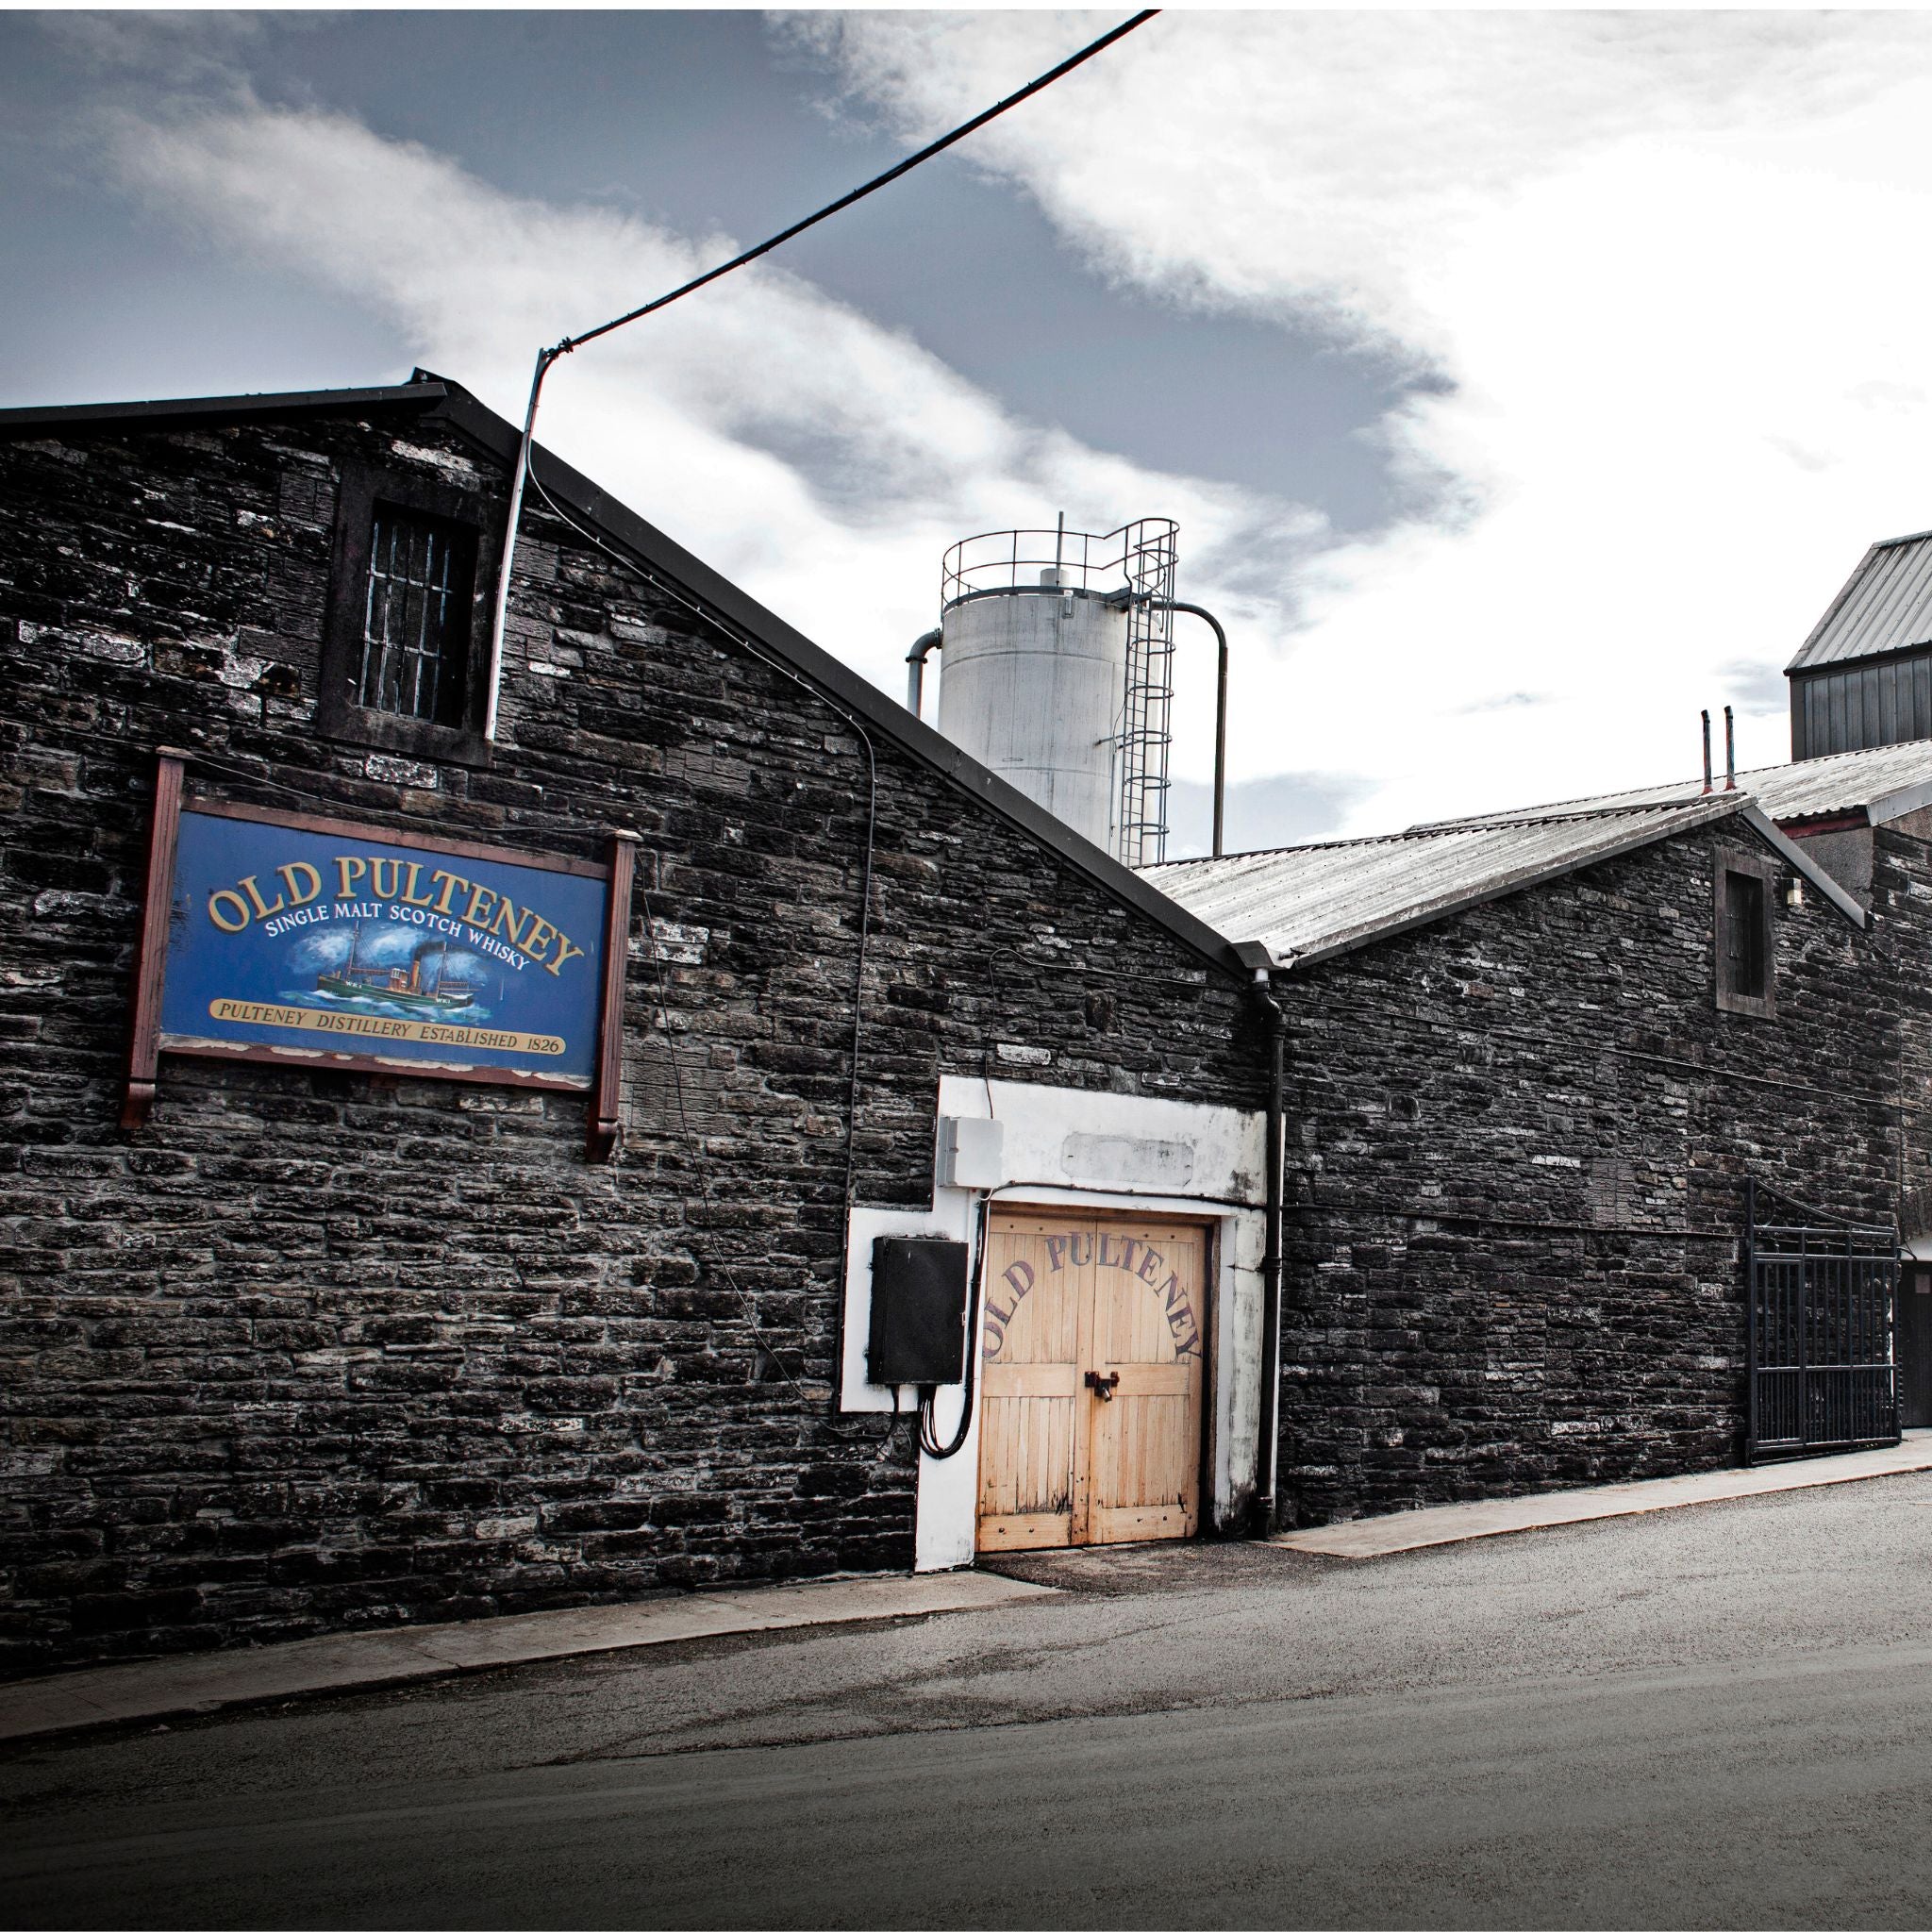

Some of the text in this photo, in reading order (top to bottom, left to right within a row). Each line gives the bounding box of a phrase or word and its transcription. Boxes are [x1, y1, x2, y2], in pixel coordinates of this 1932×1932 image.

[208, 857, 585, 976] OLD PULTENEY
[265, 903, 530, 971] SINGLE MALT SCOTCH WHISKY
[219, 1003, 559, 1053] PULTENEY DISTILLERY ESTABLISHED 1826
[1043, 1231, 1202, 1359] PULTENEY
